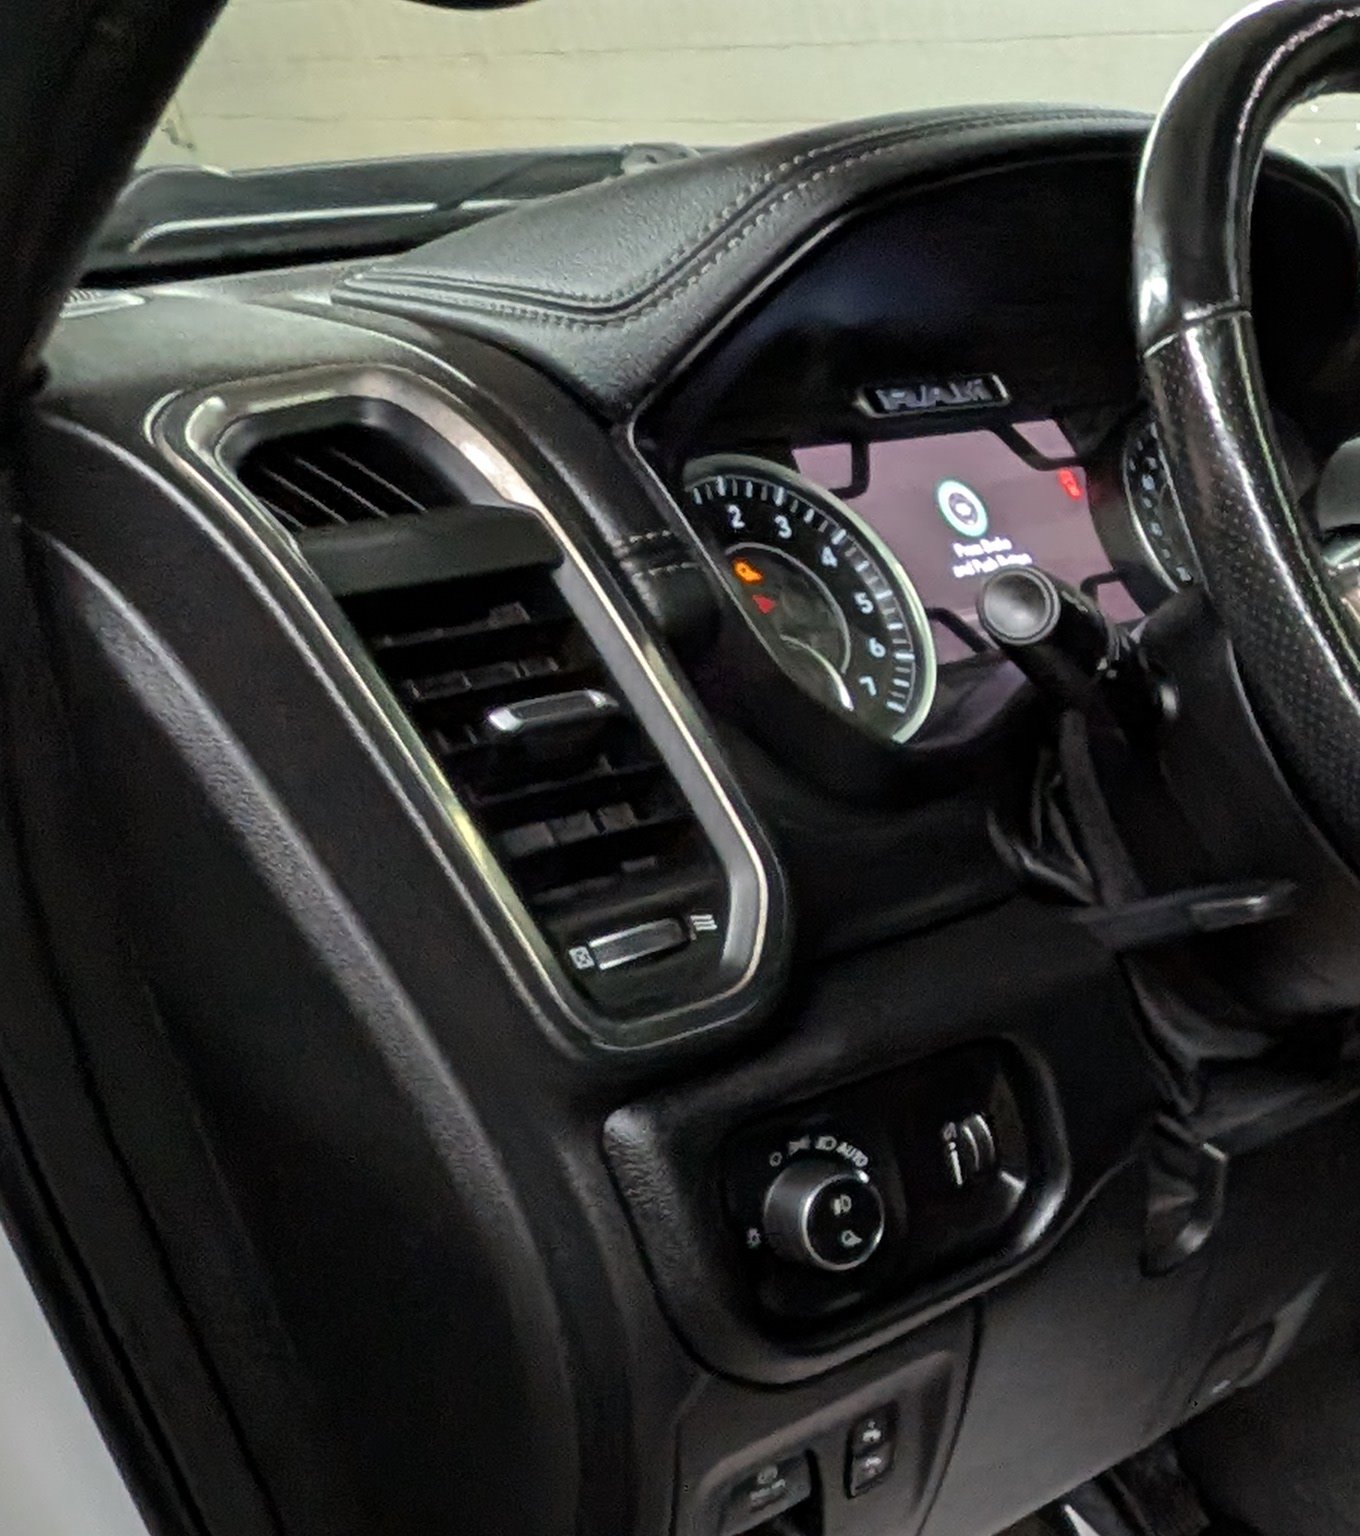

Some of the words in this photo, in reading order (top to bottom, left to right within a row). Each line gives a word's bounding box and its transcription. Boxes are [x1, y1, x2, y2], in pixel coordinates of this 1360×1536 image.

[728, 504, 745, 528] 2
[775, 515, 792, 539] 3
[821, 546, 838, 568] 4
[854, 592, 873, 614] 5
[869, 637, 886, 658] 6
[859, 675, 876, 696] 7
[836, 1141, 868, 1168] AUTO
